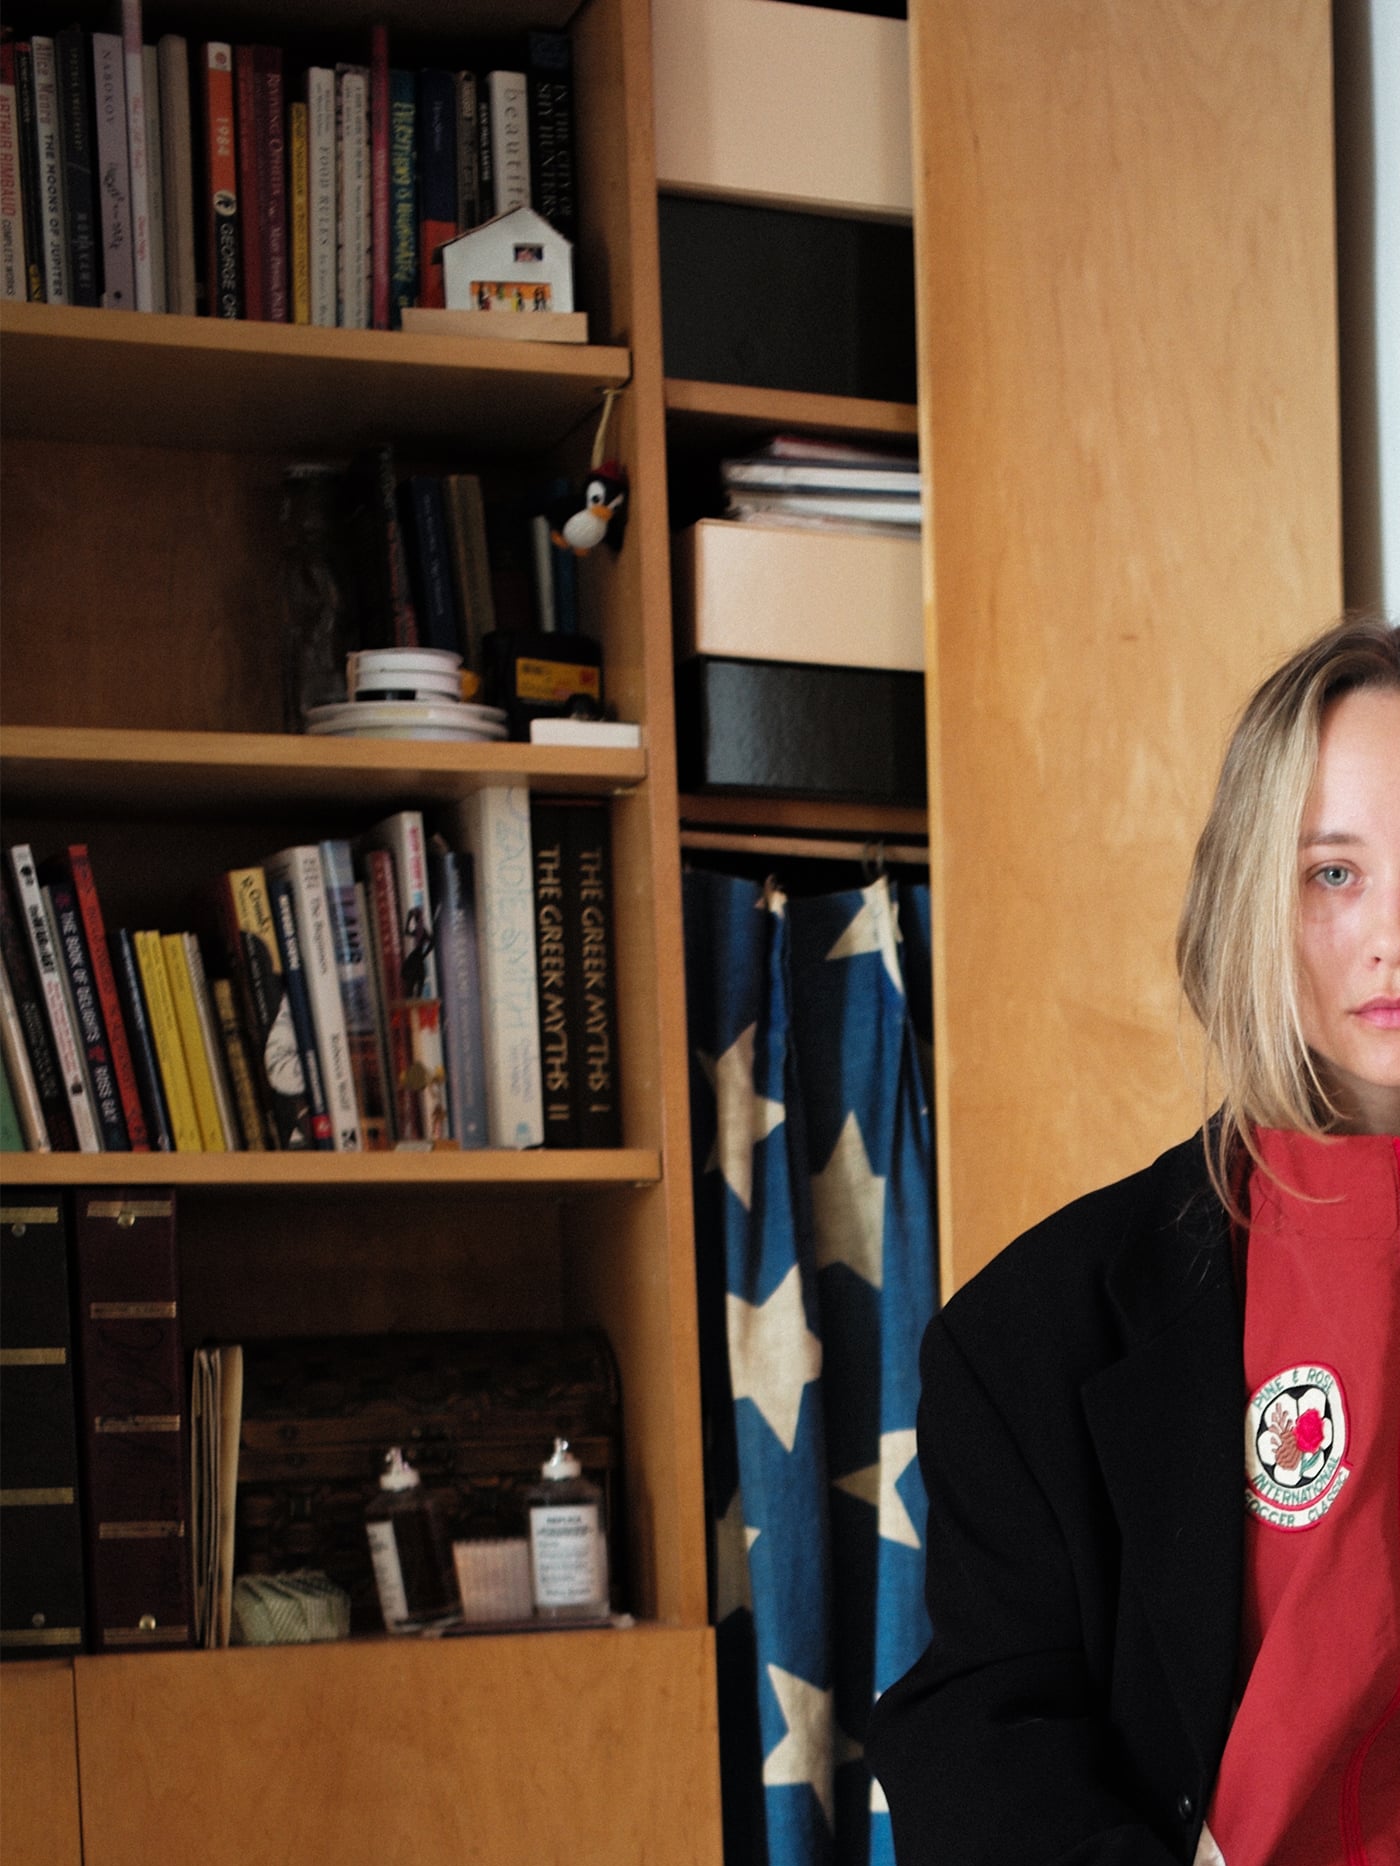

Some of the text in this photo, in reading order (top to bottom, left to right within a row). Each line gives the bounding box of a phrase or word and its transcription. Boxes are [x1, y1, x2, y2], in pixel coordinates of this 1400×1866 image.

[215, 117, 231, 157] 1984
[44, 133, 63, 296] THE MOONS OF JUPITER
[537, 843, 563, 901] THE
[578, 848, 604, 902] THE
[539, 904, 564, 987] GREEK
[581, 906, 606, 989] GREEK
[60, 910, 101, 1043] THE BOOK OF DELIGHTS
[543, 993, 569, 1091] MYTHS
[585, 994, 609, 1092] MYTHS
[93, 1065, 118, 1125] ROSS GAY
[1252, 1376, 1284, 1410] PINE
[1306, 1369, 1334, 1396] ROSE
[1252, 1457, 1340, 1506] INTERNATIONAL
[1307, 1471, 1348, 1523] CLASSIC
